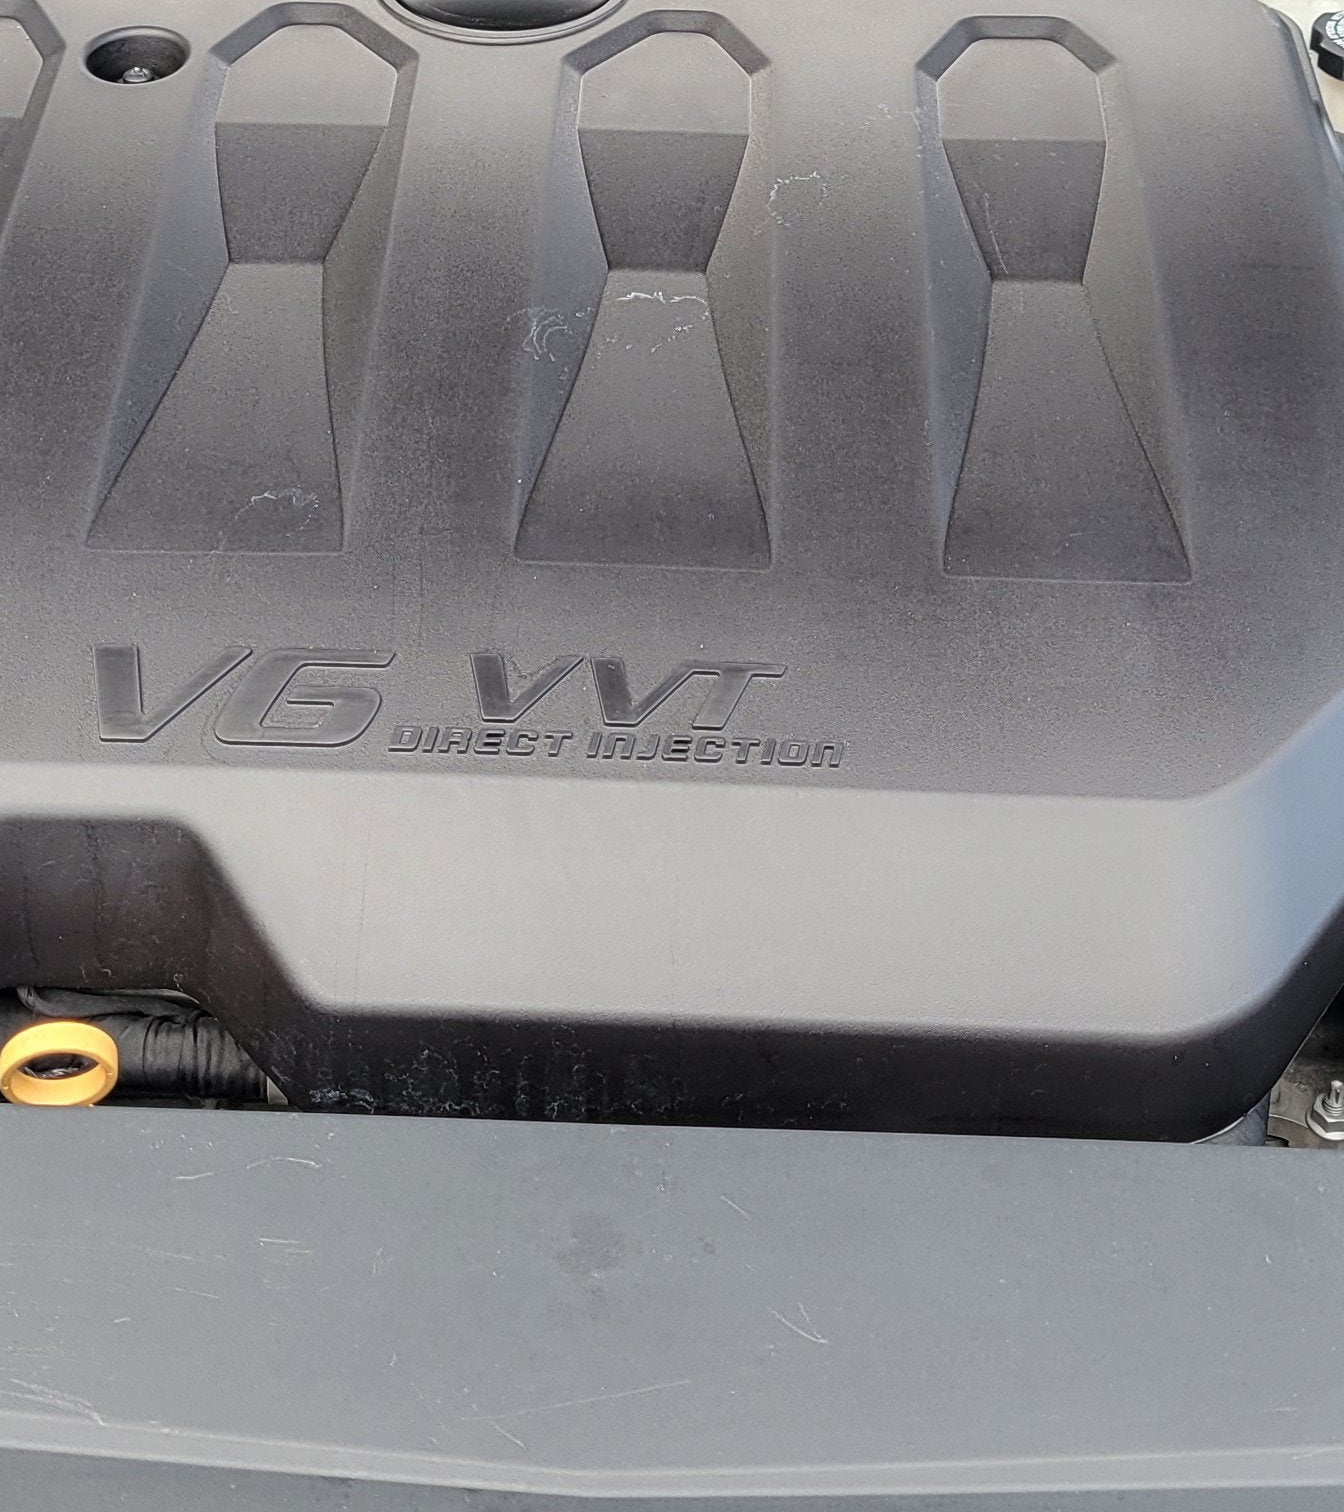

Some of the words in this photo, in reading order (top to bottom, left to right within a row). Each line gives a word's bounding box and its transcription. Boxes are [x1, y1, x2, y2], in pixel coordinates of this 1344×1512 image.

[93, 644, 396, 749] V6
[470, 652, 787, 730] VVT
[387, 725, 573, 758] DIRECT
[586, 731, 846, 768] INJECTION
